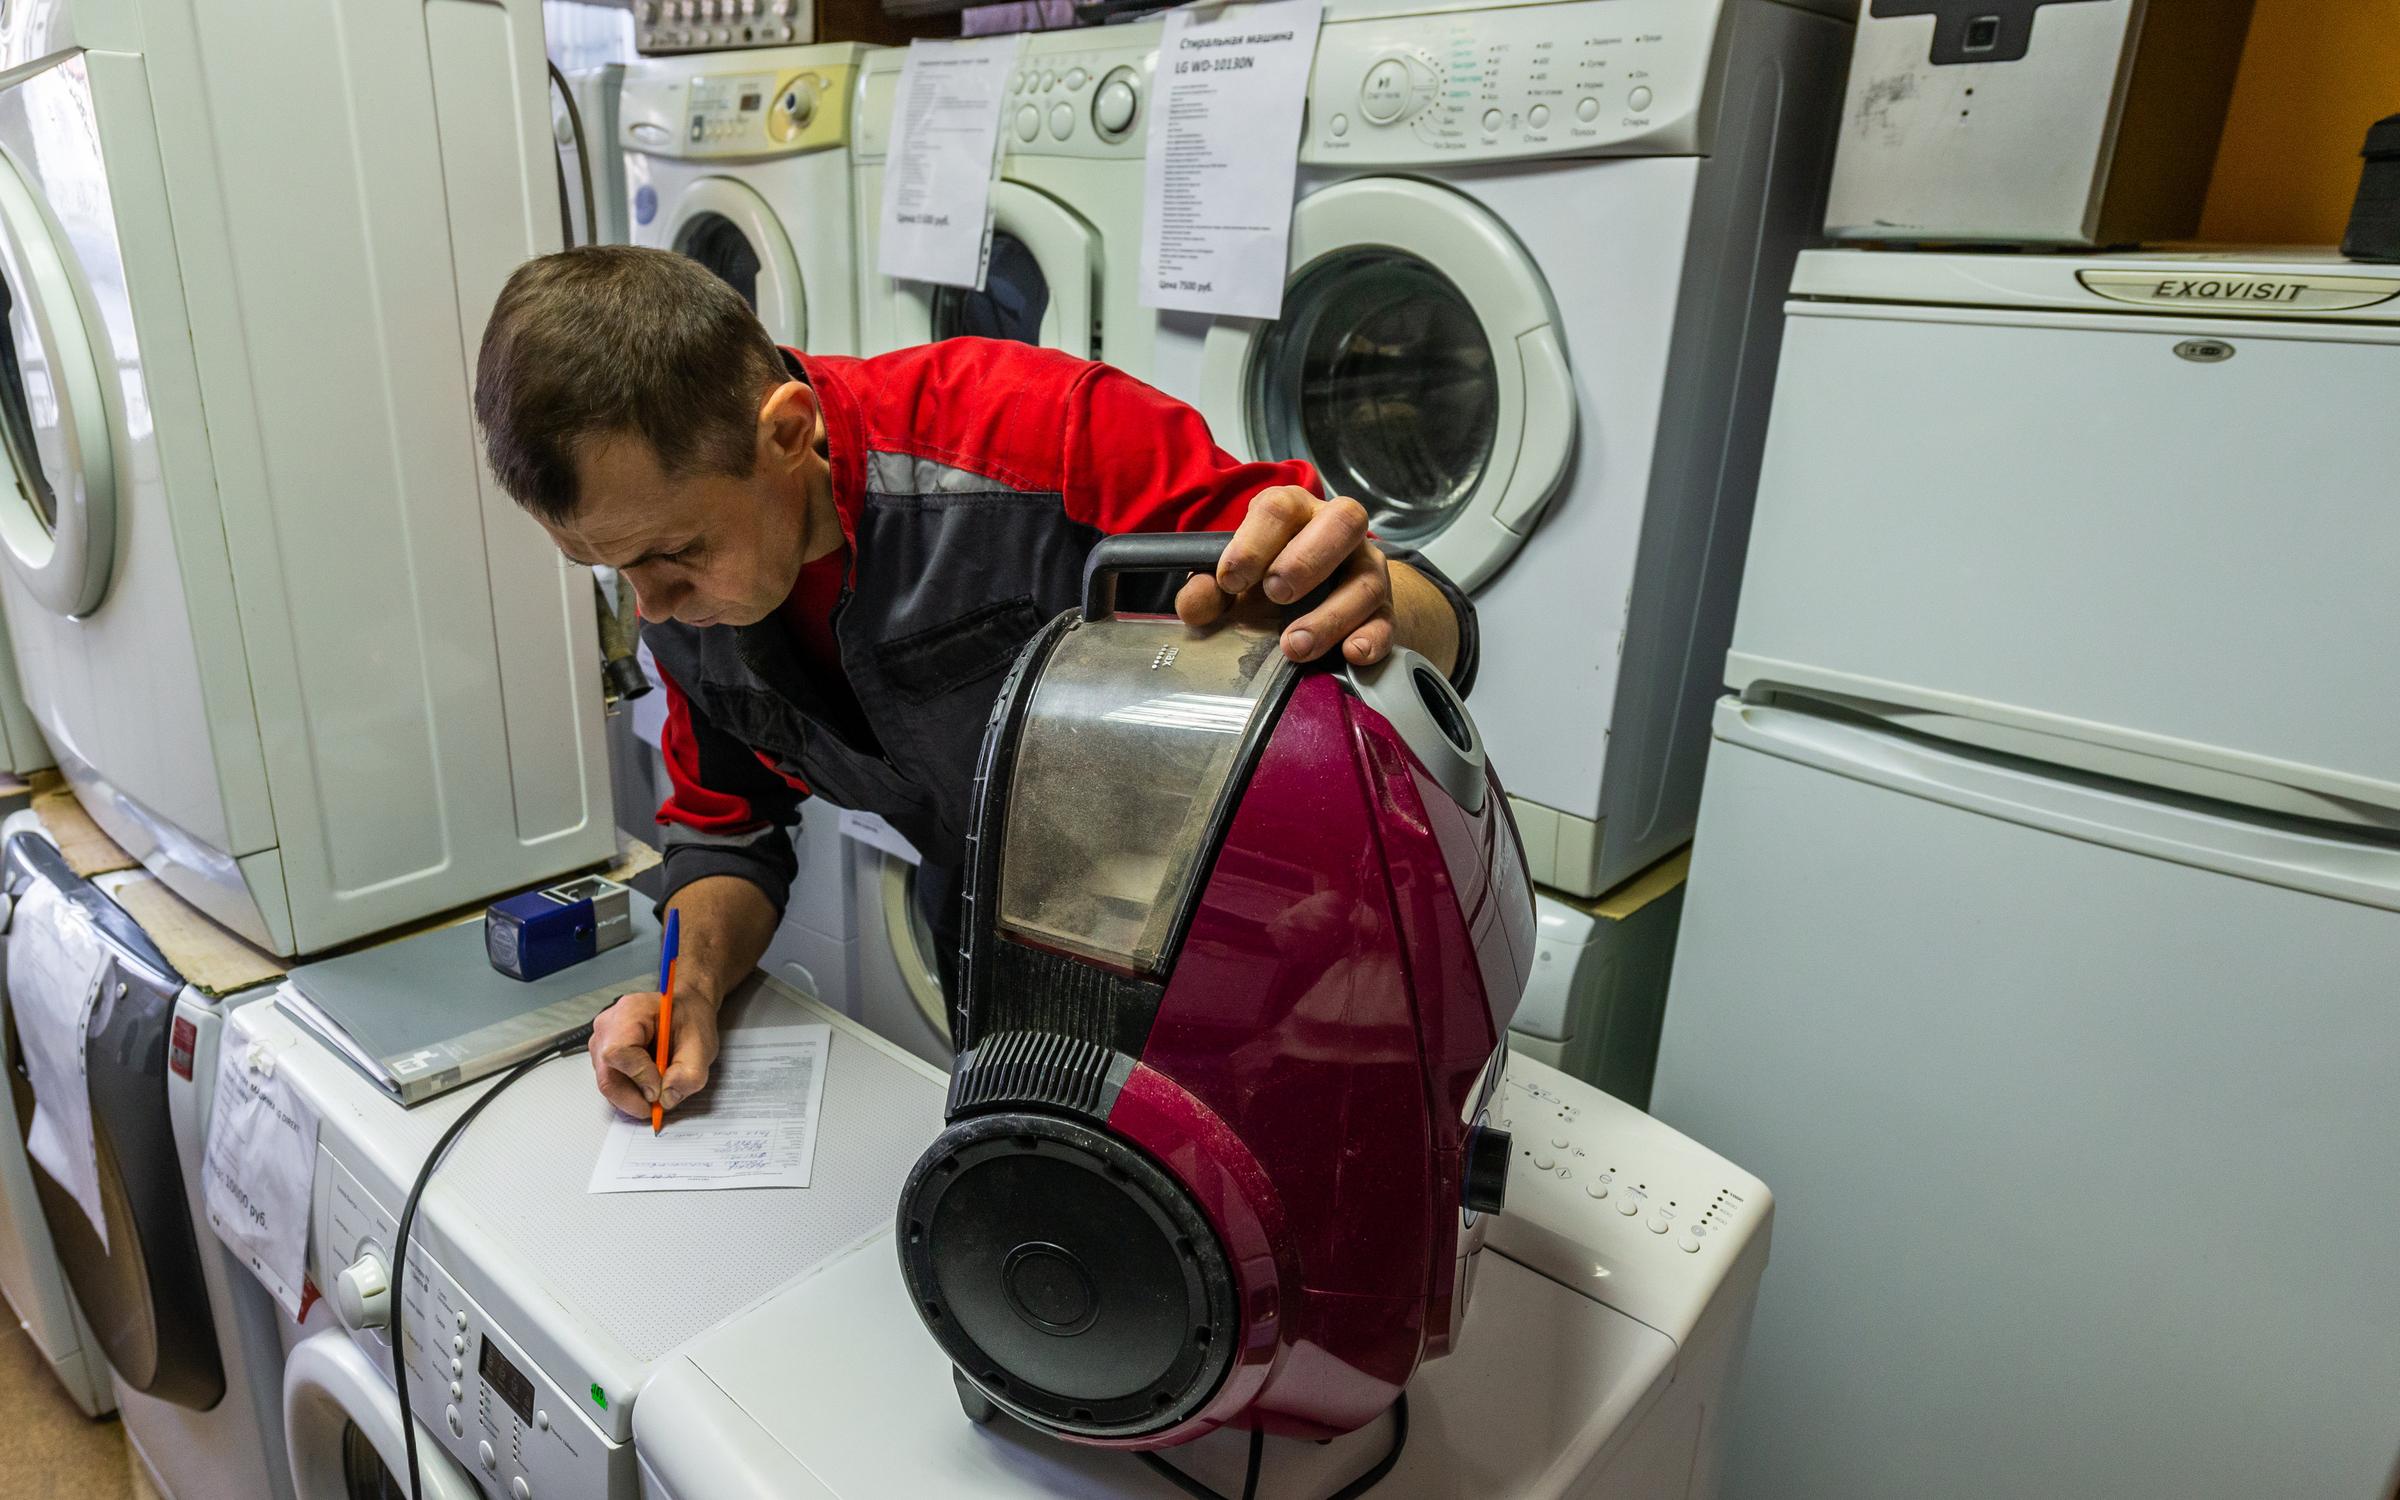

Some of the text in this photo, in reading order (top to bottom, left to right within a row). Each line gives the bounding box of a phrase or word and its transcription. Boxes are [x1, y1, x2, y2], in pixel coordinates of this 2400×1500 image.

[1180, 31, 1294, 50] Стиральная машина
[1175, 61, 1189, 74] LG
[1159, 280, 1177, 290] Цена
[1197, 282, 1213, 294] руб.
[2154, 280, 2308, 302] EXQVISIT
[1162, 647, 1179, 666] max
